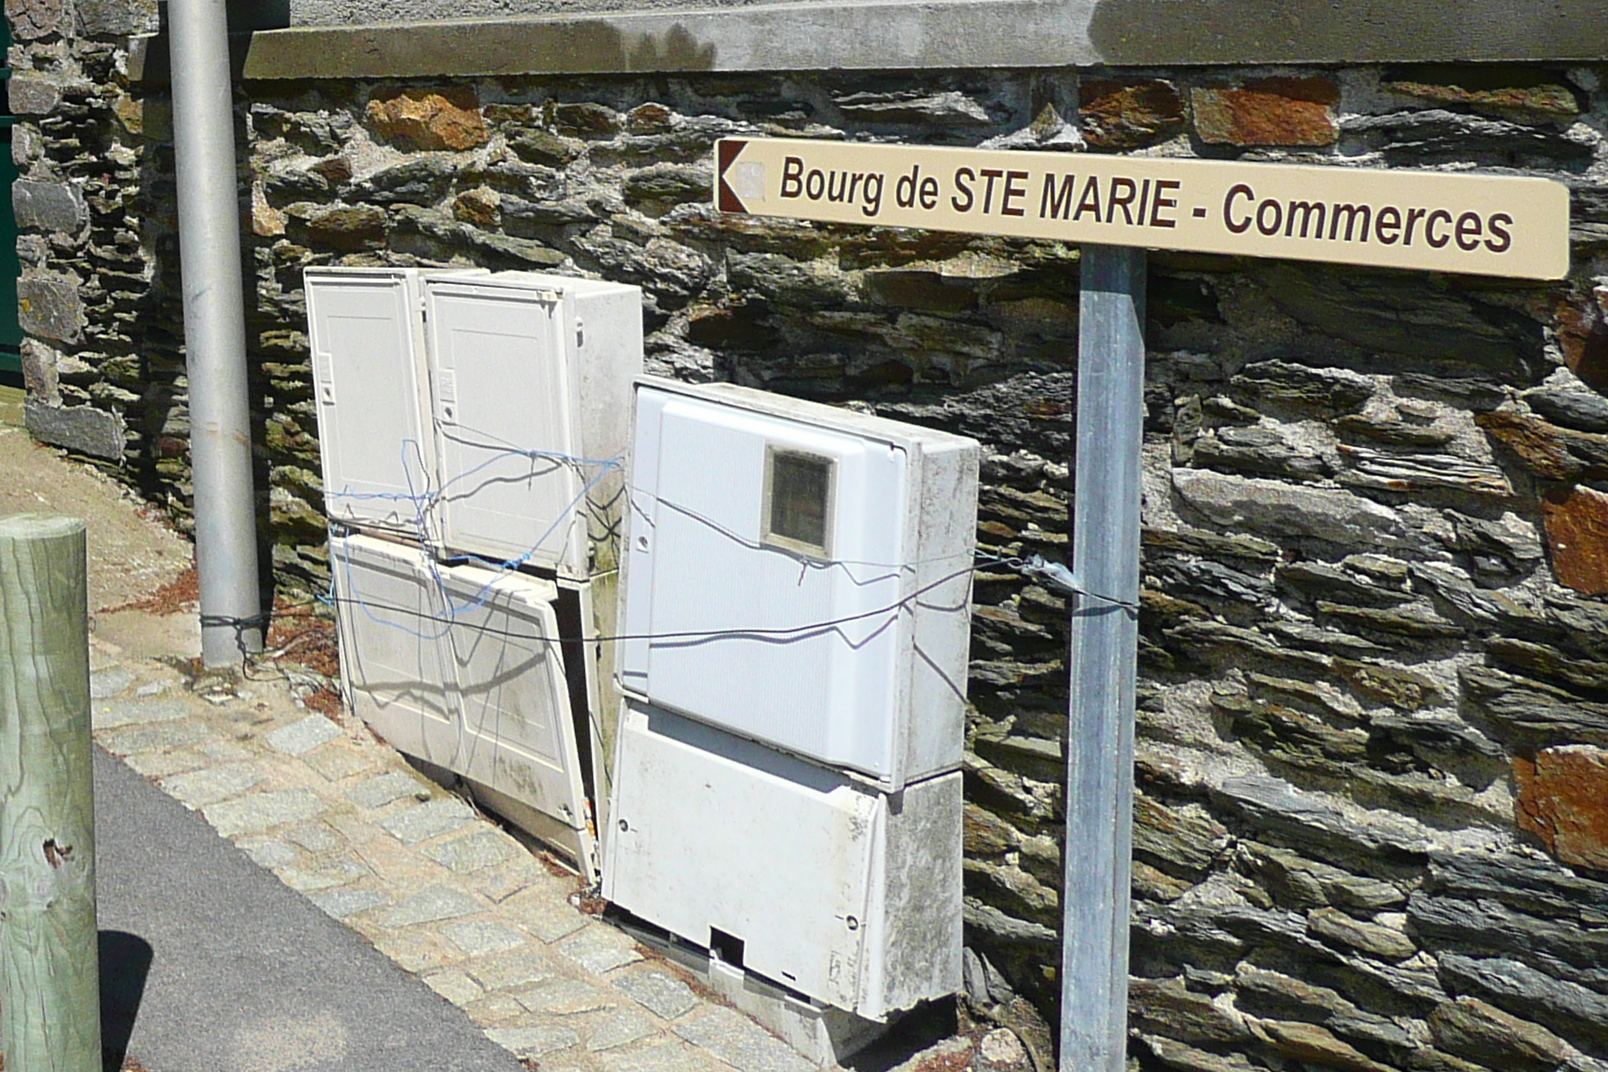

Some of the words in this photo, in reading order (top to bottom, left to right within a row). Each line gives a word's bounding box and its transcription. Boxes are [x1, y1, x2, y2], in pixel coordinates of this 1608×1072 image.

[779, 155, 885, 218] Bourg
[895, 163, 939, 211] de
[950, 166, 1030, 218] STE
[1038, 172, 1182, 230] MARIE
[1222, 182, 1514, 254] Commerces
